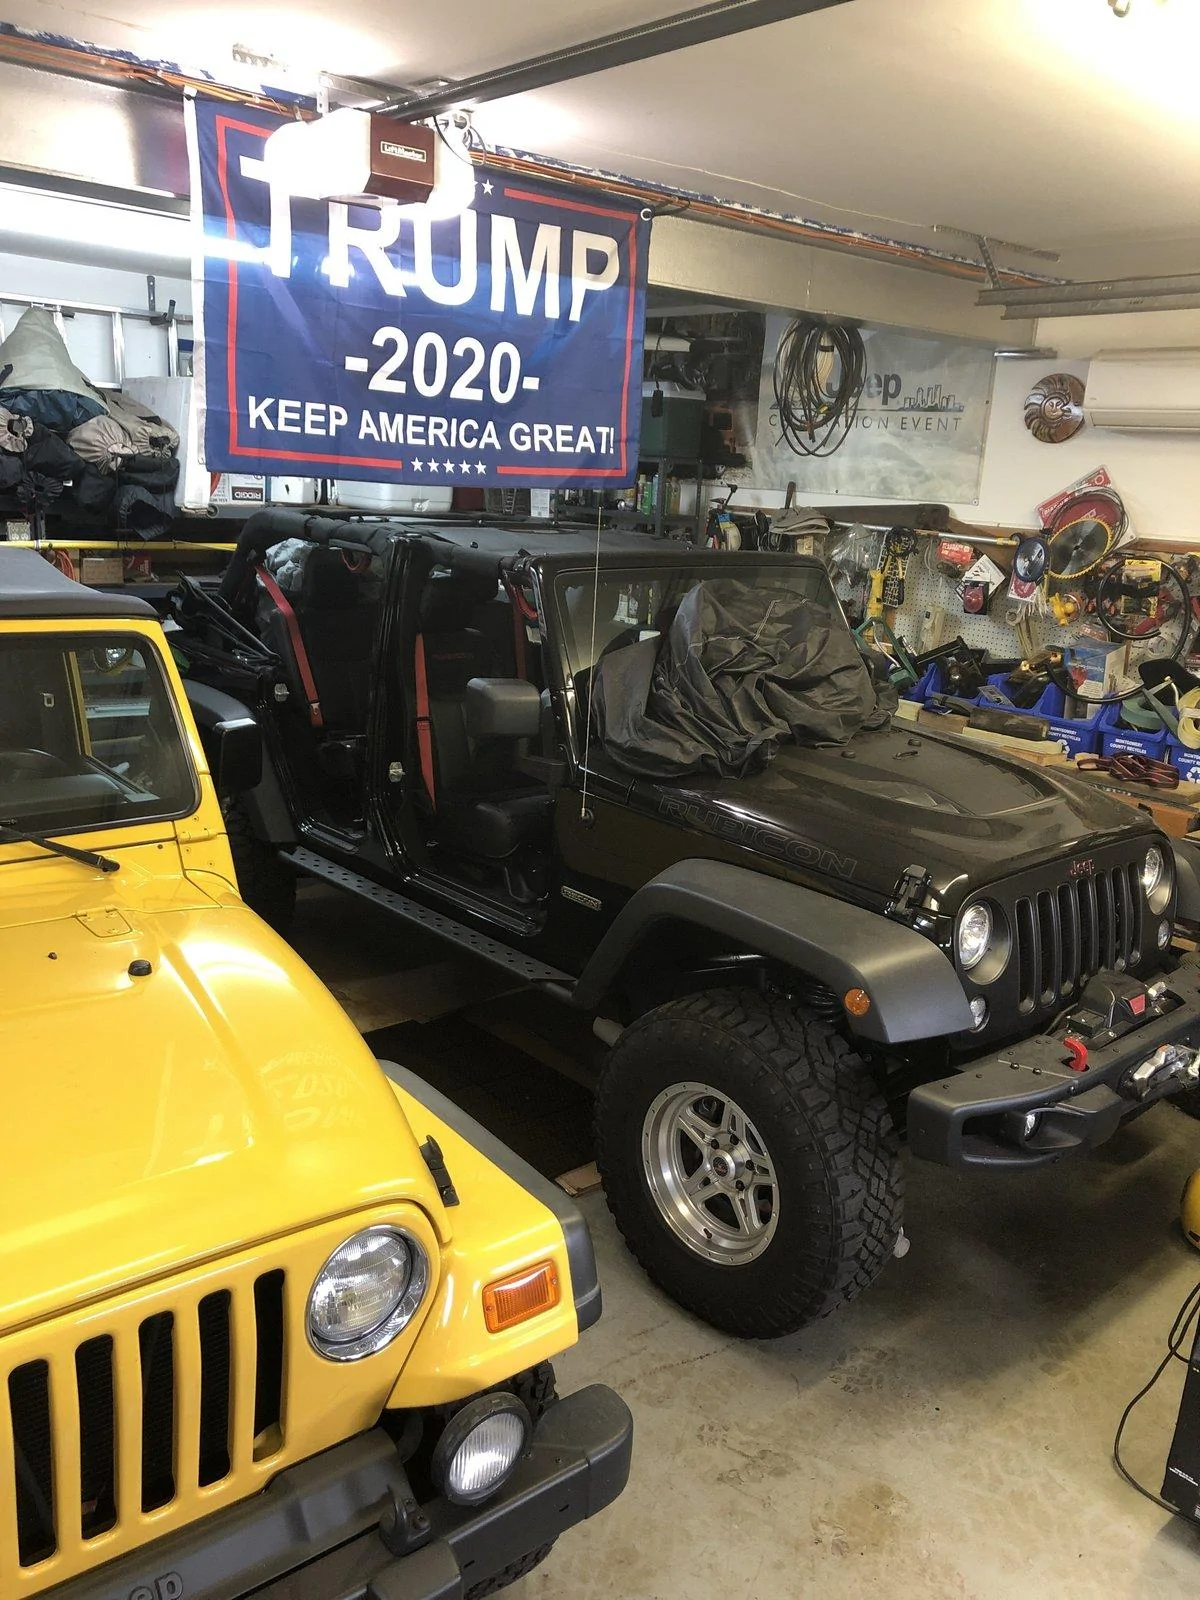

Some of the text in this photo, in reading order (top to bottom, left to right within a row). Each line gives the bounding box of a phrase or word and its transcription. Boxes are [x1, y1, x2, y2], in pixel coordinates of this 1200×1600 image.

[240, 155, 620, 323] TRUMP
[248, 395, 615, 455] KEEP AMERICA GREAT!
[900, 415, 963, 432] EVENT
[234, 491, 262, 500] RIDGID
[1050, 726, 1077, 735] MONTGOMERY
[1115, 738, 1143, 748] MONTGOMERY
[1126, 746, 1147, 755] RECYCLES
[1177, 757, 1196, 765] COUNTY
[658, 795, 858, 877] RUBICON
